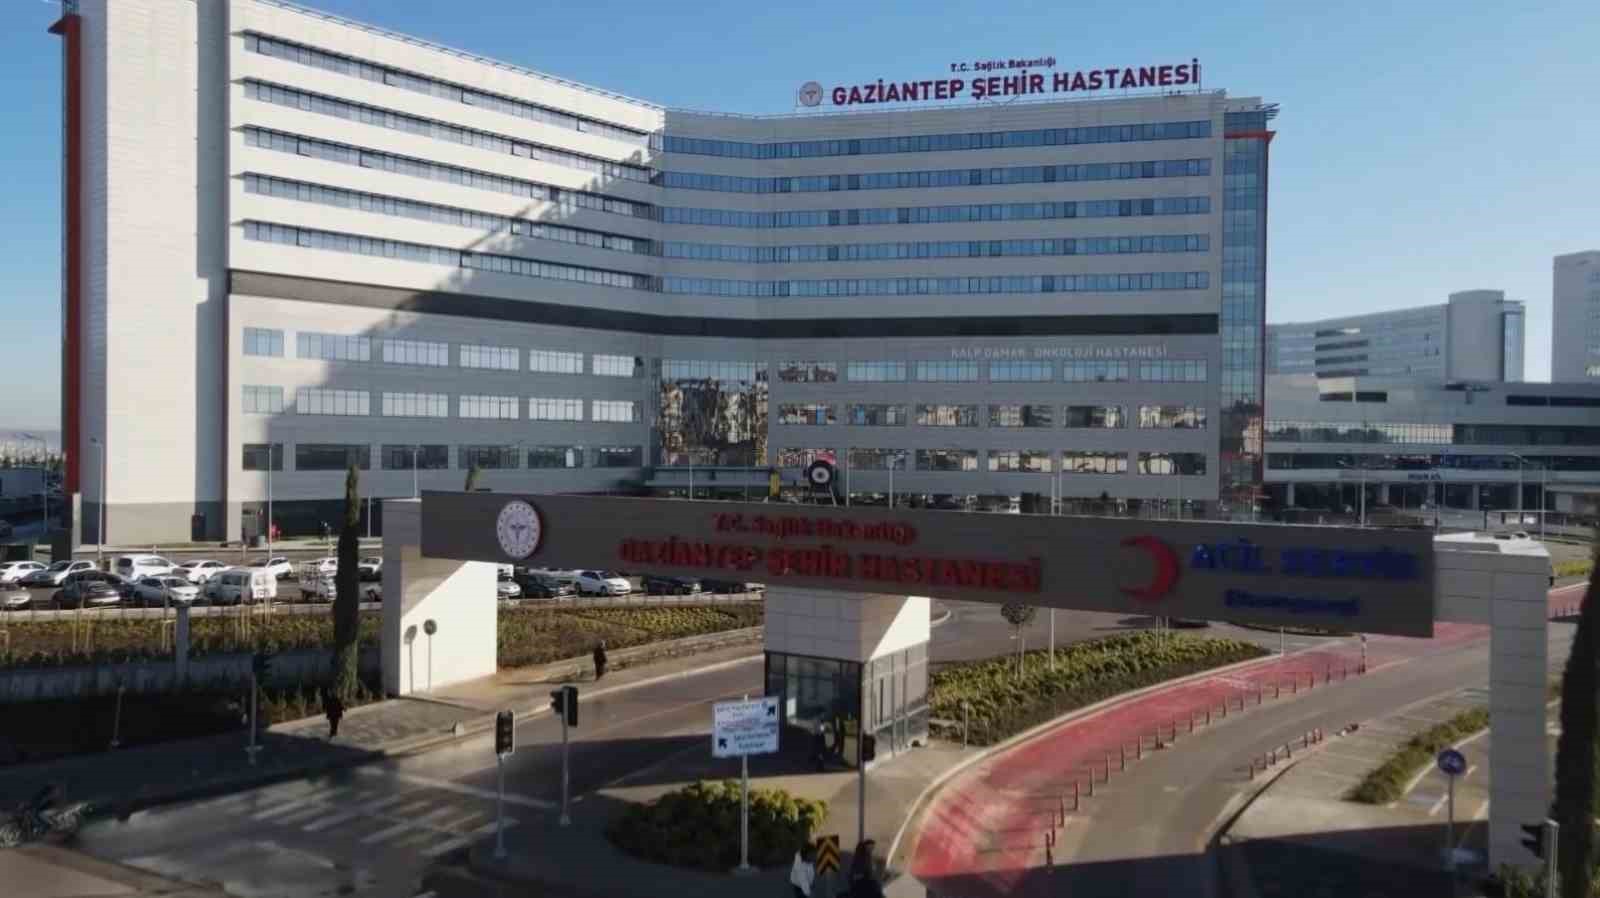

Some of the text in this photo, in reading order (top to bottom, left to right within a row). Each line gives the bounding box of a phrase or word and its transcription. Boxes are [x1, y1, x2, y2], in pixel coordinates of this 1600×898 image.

[951, 56, 1056, 72] T.C. Sağlık Bakanlığı
[832, 58, 1198, 105] GAZİANTEP ŞEHİR HASTANESİ
[1096, 344, 1167, 358] HASTANESİ
